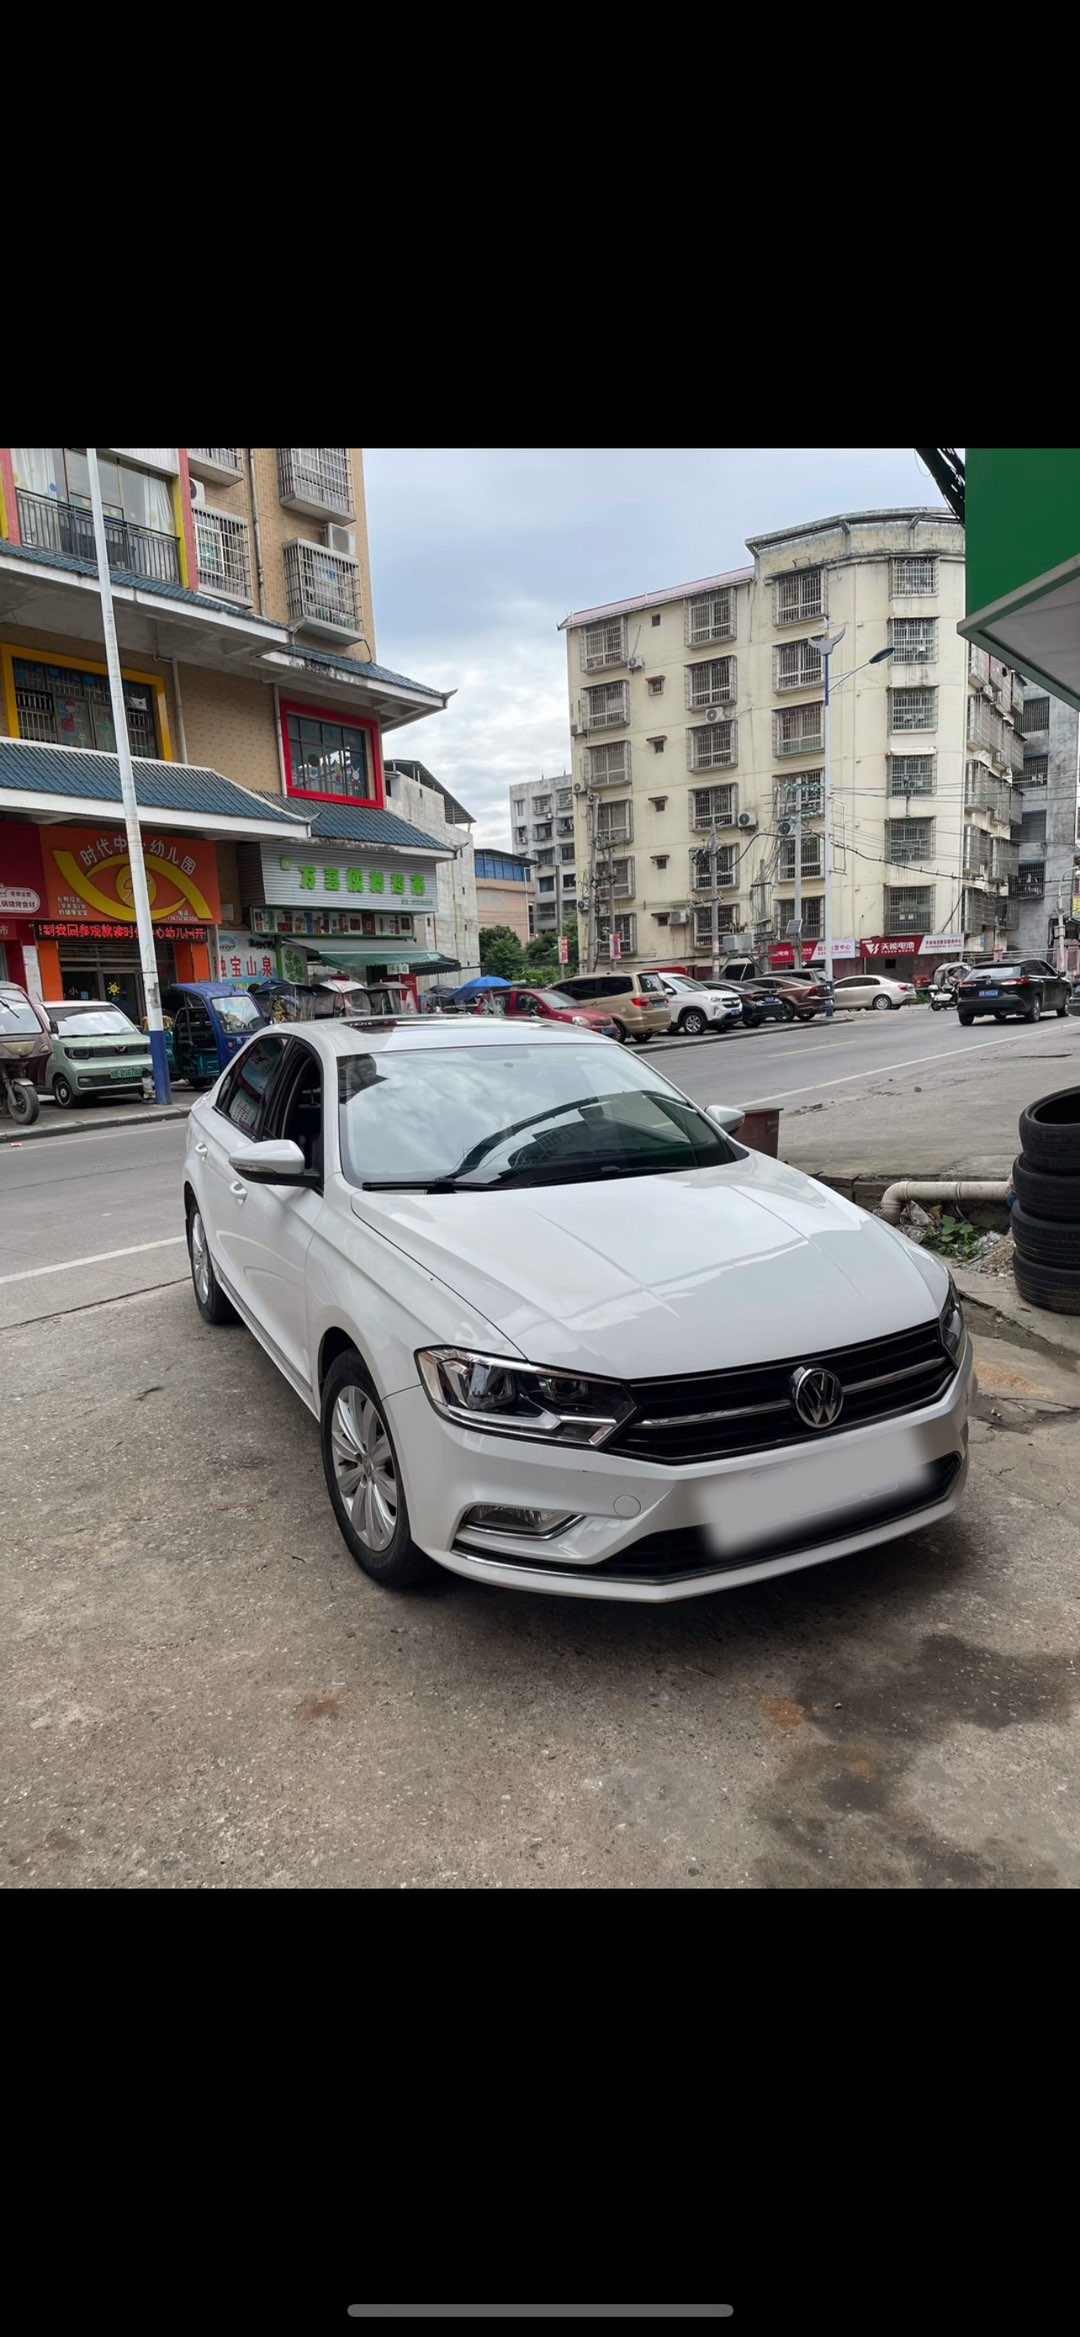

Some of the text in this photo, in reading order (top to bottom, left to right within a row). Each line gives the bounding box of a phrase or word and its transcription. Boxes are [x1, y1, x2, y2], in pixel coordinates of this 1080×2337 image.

[79, 835, 197, 876] 时代中幼儿园
[0, 900, 35, 908] 锅烧烤食材
[880, 941, 915, 950] 天能电池
